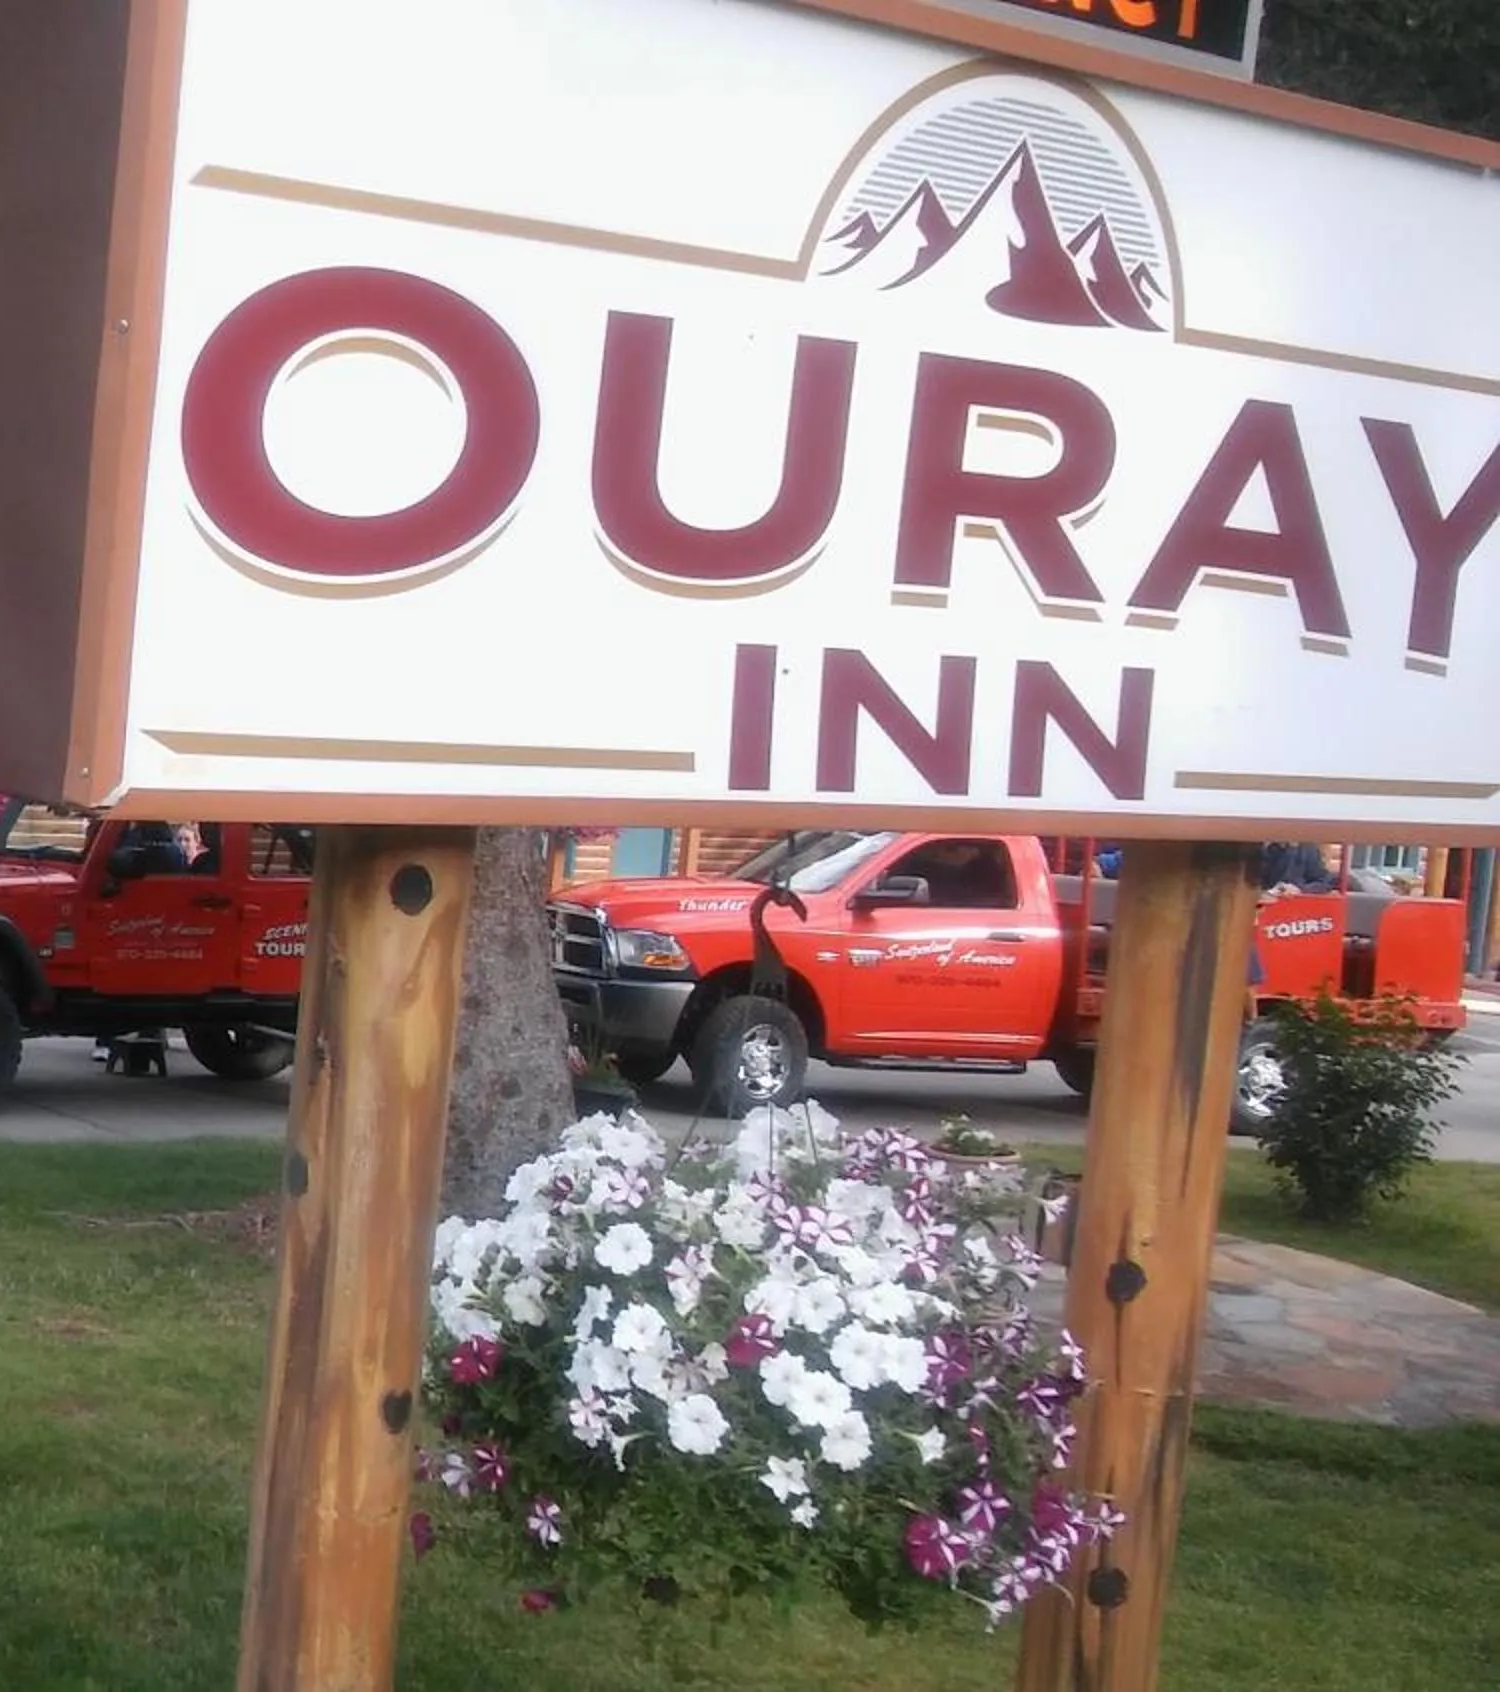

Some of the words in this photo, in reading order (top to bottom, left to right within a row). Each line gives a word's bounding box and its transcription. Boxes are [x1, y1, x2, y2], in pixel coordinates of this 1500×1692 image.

[180, 264, 1500, 664] OURAY
[728, 642, 1155, 801] INN
[255, 942, 306, 956] TOUR
[1263, 917, 1334, 939] TOURS
